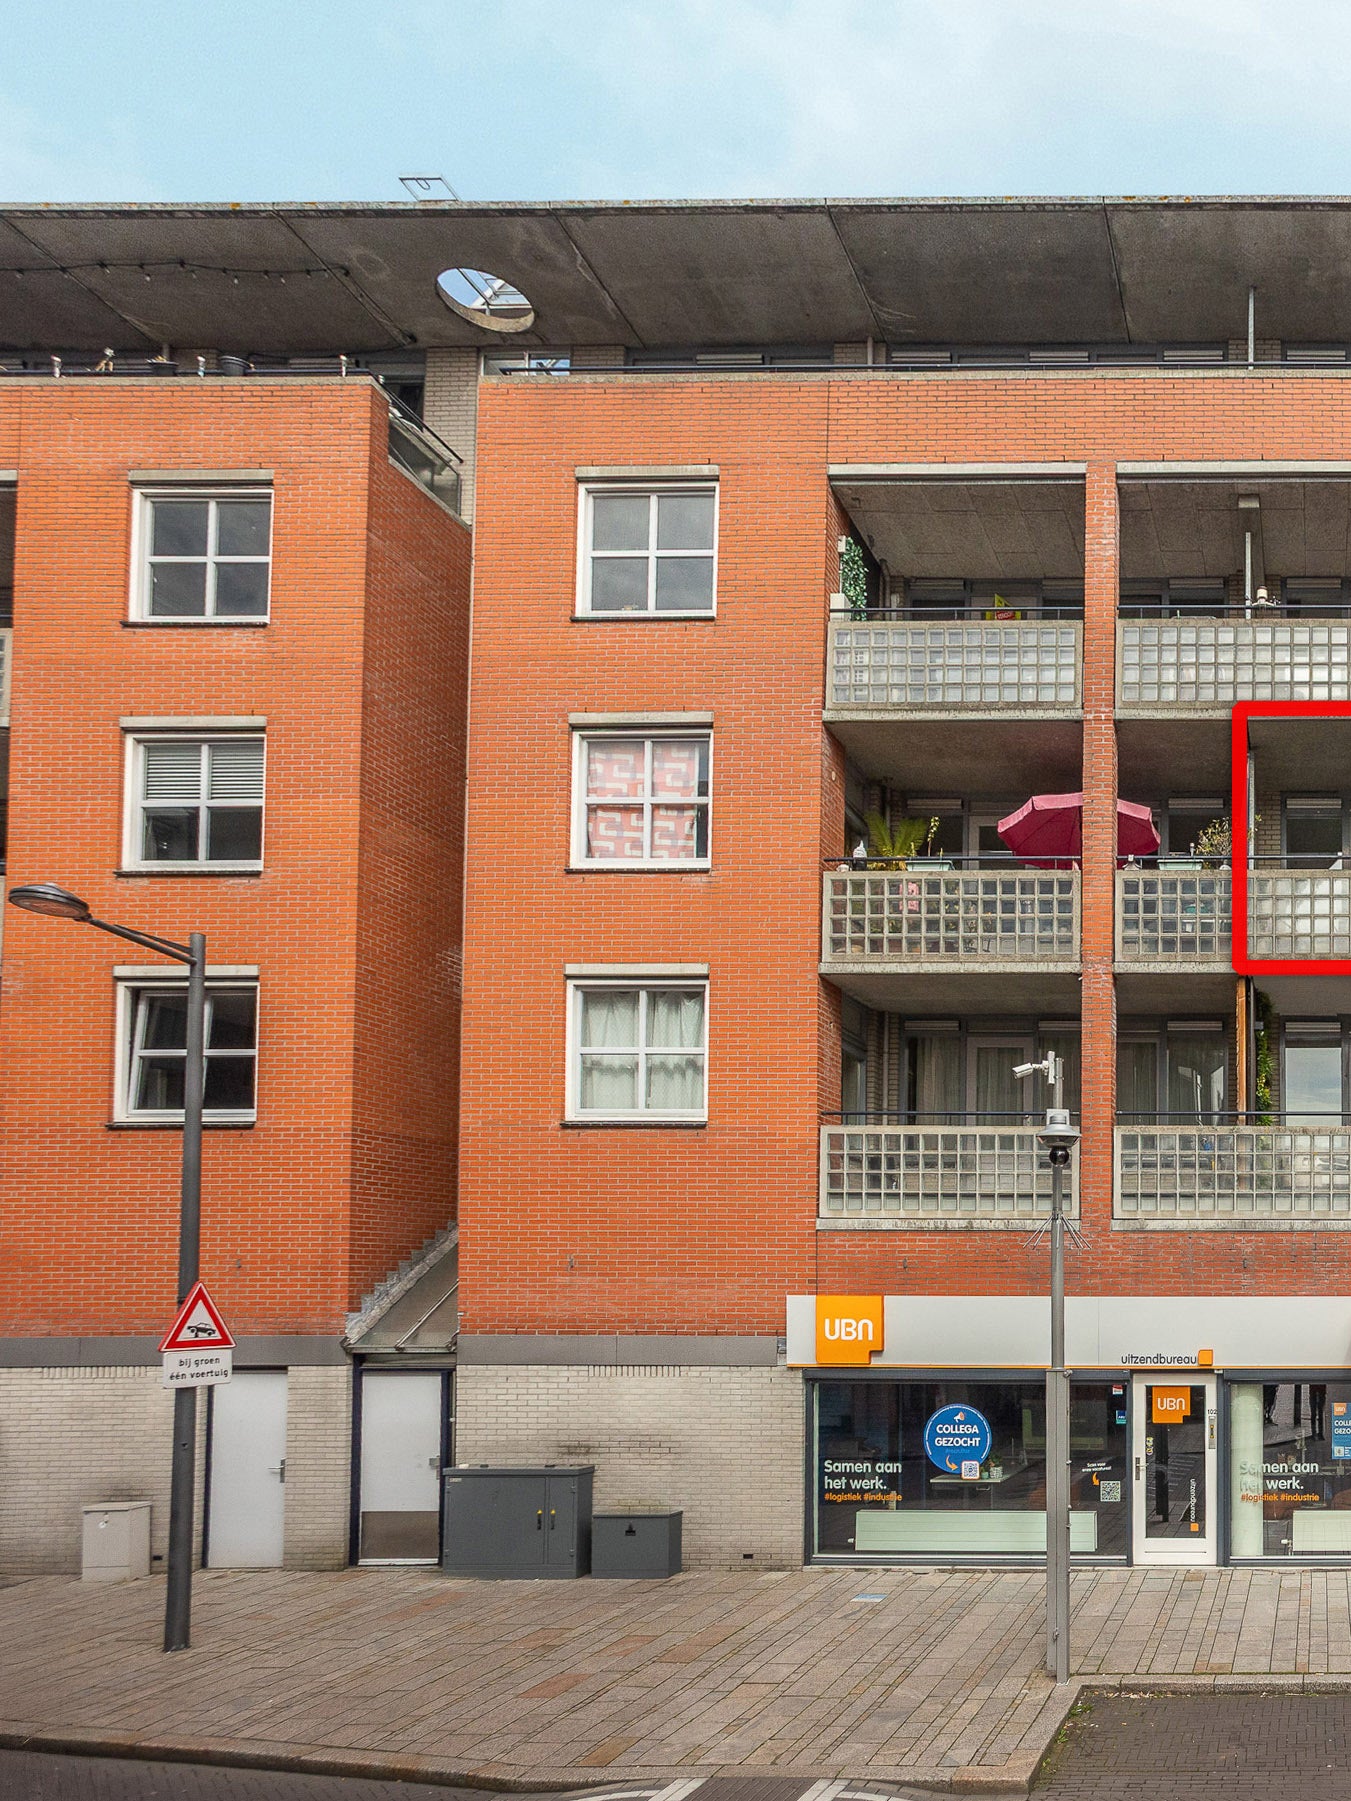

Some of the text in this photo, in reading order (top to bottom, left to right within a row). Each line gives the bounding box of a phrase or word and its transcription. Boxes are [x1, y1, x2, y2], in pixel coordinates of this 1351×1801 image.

[179, 1357, 220, 1368] bij groen
[1121, 1353, 1197, 1364] uitzendbureau
[169, 1368, 228, 1380] één voertuig
[936, 1424, 980, 1434] COLLEGA
[934, 1437, 981, 1447] GEZOCHT
[824, 1460, 902, 1473] Samen aan
[1240, 1461, 1319, 1475] Samen aan
[824, 1475, 887, 1490] het werk.
[1266, 1476, 1304, 1490] werk.
[824, 1492, 862, 1502] #logistiek
[1241, 1493, 1320, 1503] #logistiek #industrie
